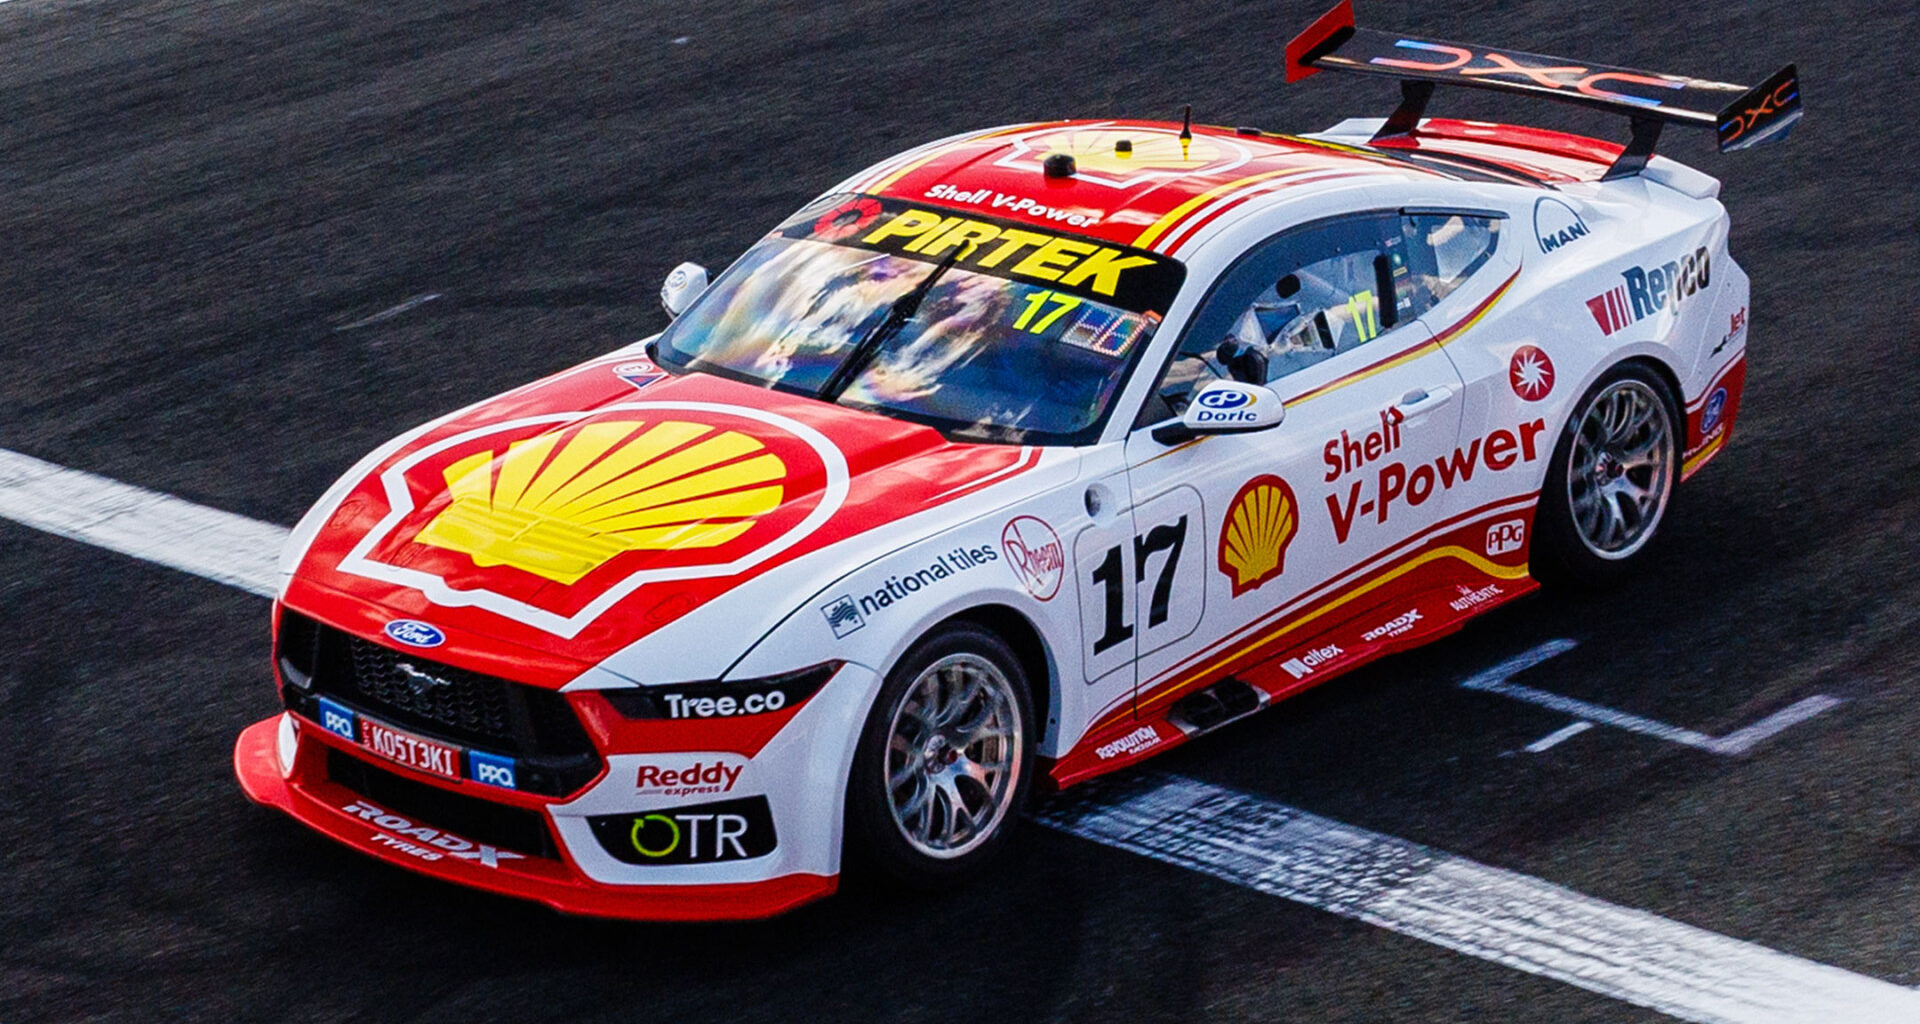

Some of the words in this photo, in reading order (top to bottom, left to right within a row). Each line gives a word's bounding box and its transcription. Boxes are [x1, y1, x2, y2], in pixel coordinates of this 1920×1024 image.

[924, 183, 993, 205] Shell
[991, 193, 1101, 228] V-Power
[861, 208, 1157, 296] PIRTEK
[1542, 222, 1586, 252] MAN
[1621, 245, 1711, 322] Repco
[1012, 289, 1083, 335] 17
[1346, 289, 1377, 343] 17
[1197, 410, 1257, 421] Doric
[1323, 406, 1404, 483] Shell
[1325, 417, 1546, 545] V-Power
[1488, 524, 1524, 551] PPG
[859, 555, 956, 616] national
[950, 543, 998, 572] tiles
[1092, 514, 1188, 656] 17
[1360, 608, 1424, 641] ROADX
[664, 690, 786, 718] Tree.co
[325, 711, 353, 738] PPQ
[478, 763, 515, 787] PPQ
[636, 761, 743, 792] Reddy
[665, 785, 720, 797] express
[342, 800, 526, 869] ROADX
[370, 833, 444, 861] TYRES
